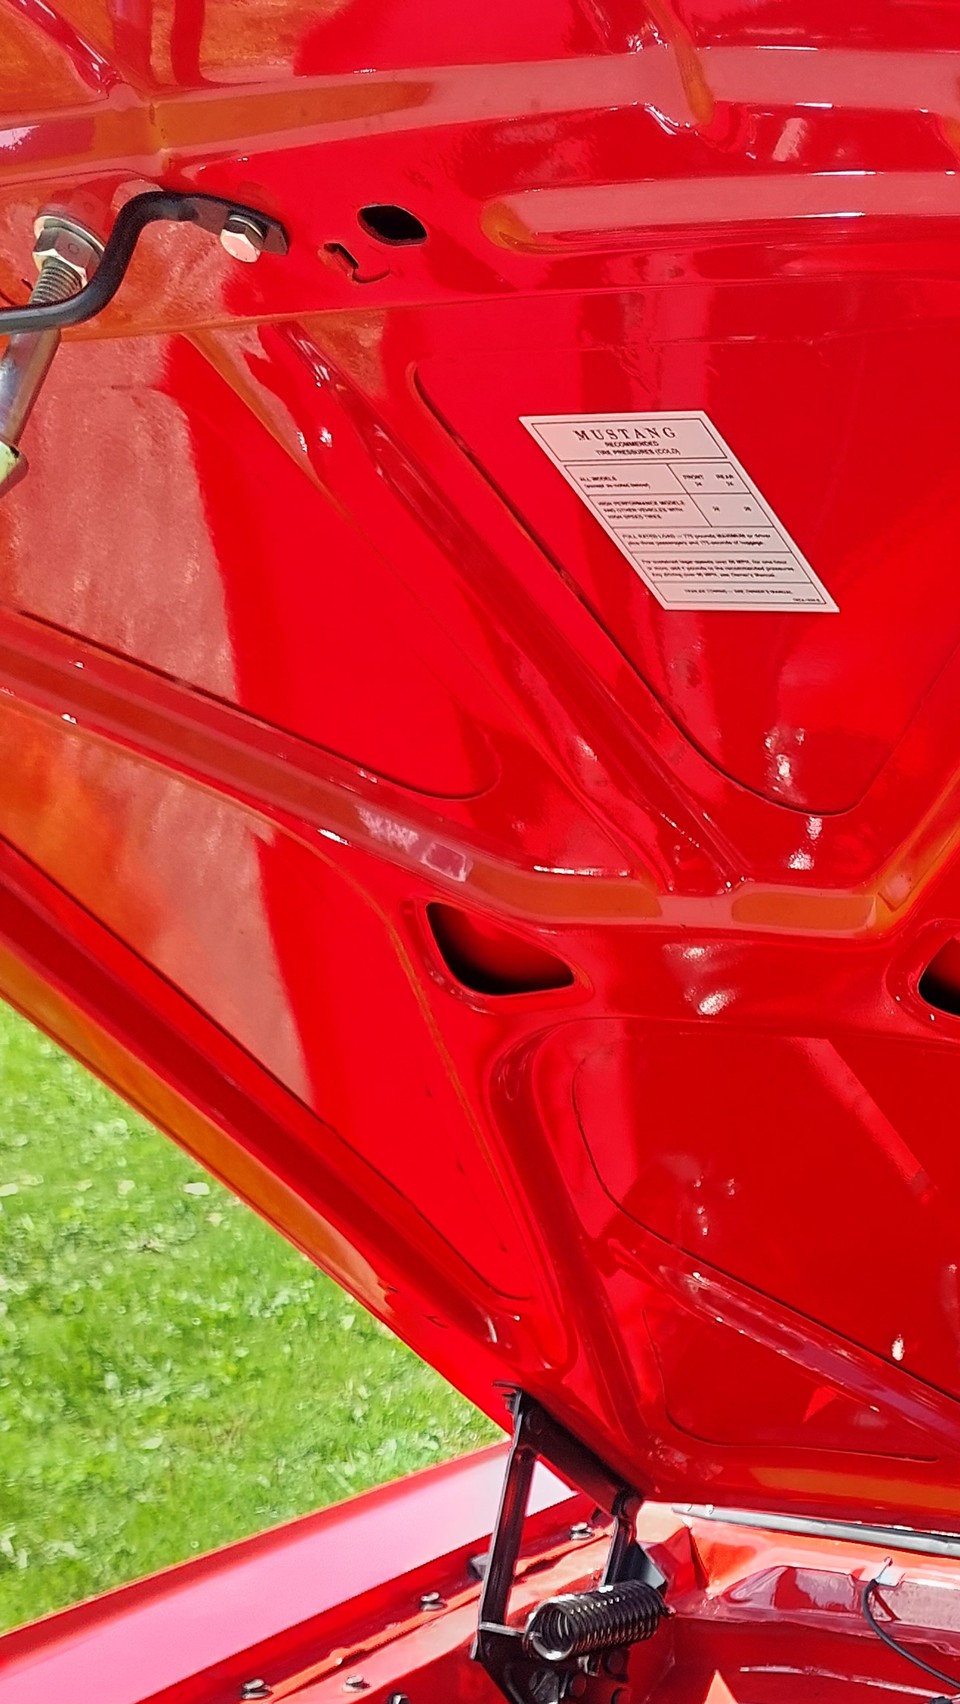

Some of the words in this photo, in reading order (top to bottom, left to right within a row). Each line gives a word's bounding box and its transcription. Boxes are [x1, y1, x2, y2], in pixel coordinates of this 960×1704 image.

[572, 427, 676, 441] MUSTANG
[604, 440, 660, 448] RECOMMENDED
[613, 448, 655, 456] PRESSURES
[655, 447, 681, 456] (COLD)
